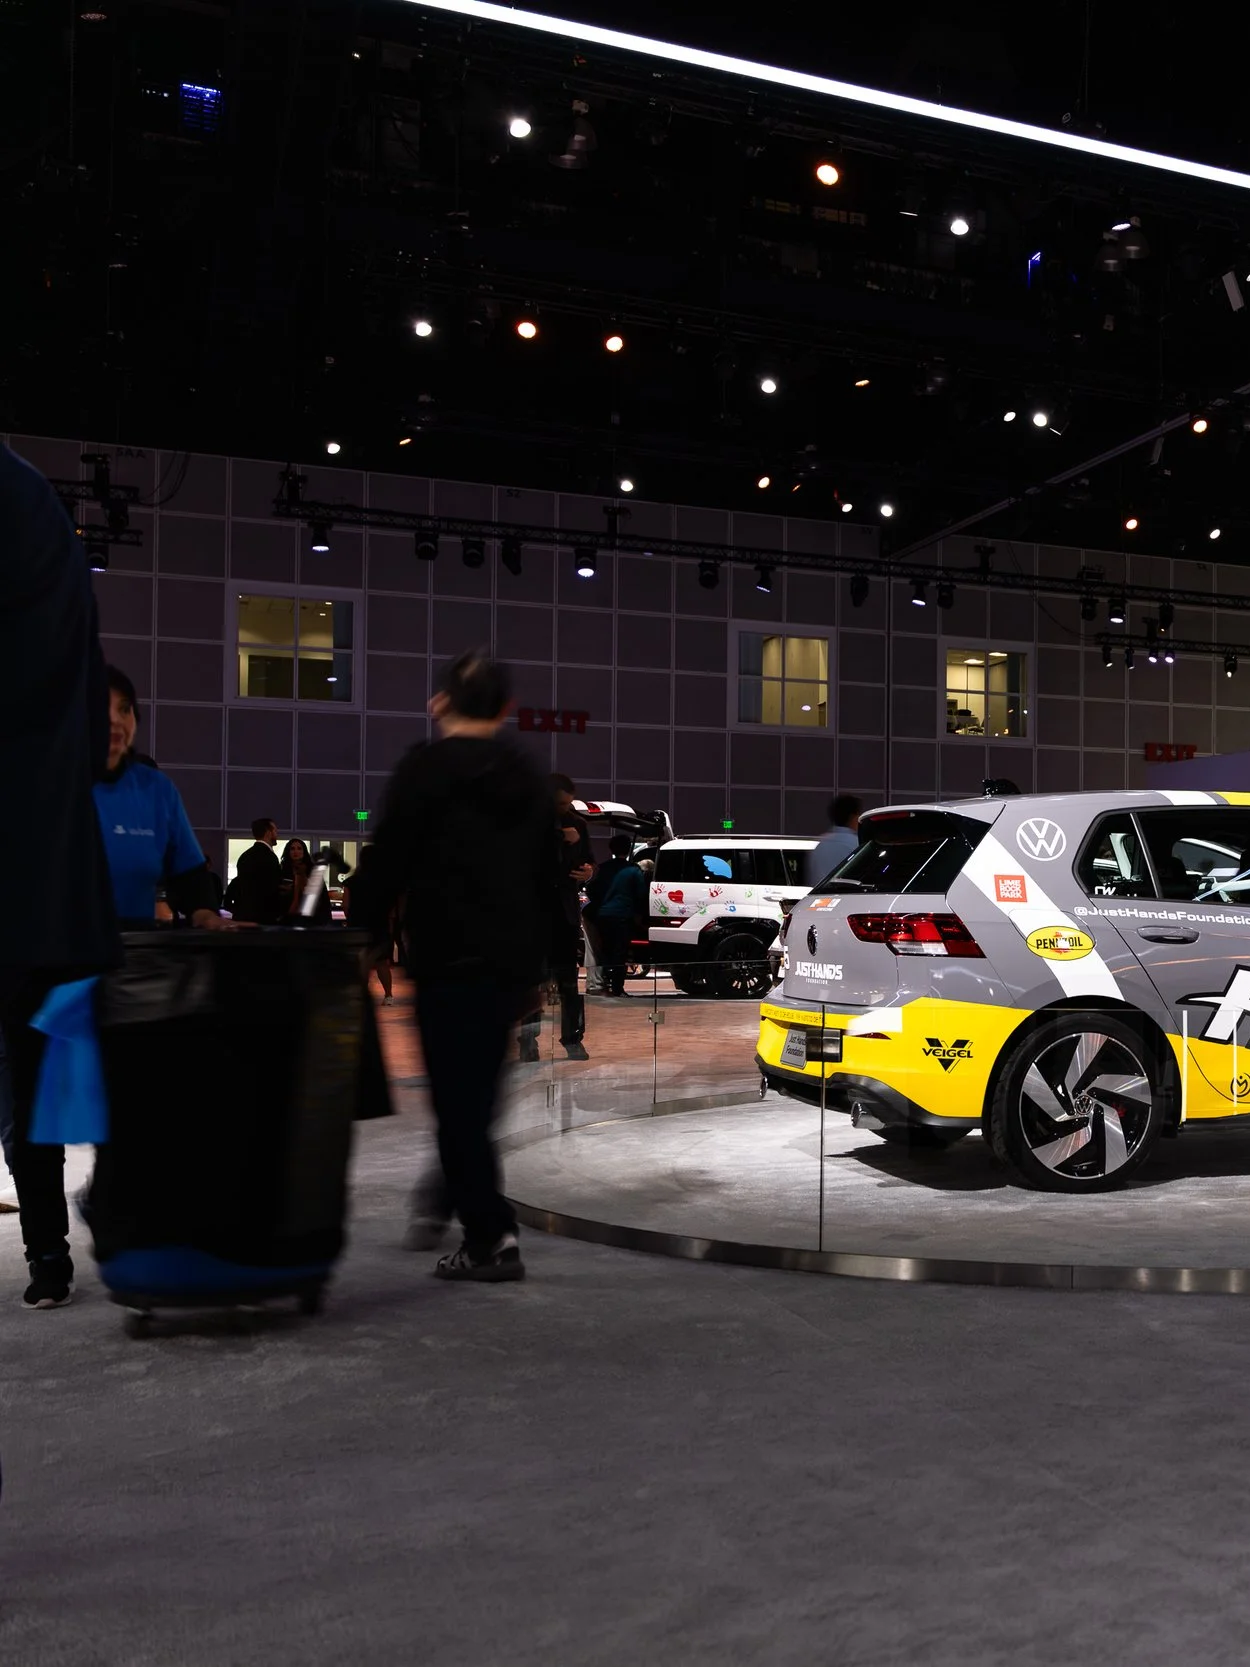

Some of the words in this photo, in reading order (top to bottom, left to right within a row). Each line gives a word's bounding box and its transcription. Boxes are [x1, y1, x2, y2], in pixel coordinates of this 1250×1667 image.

[518, 708, 590, 733] EXIT
[1144, 742, 1197, 761] EXIT
[1000, 891, 1023, 899] PARK
[1036, 937, 1083, 950] PENOIL
